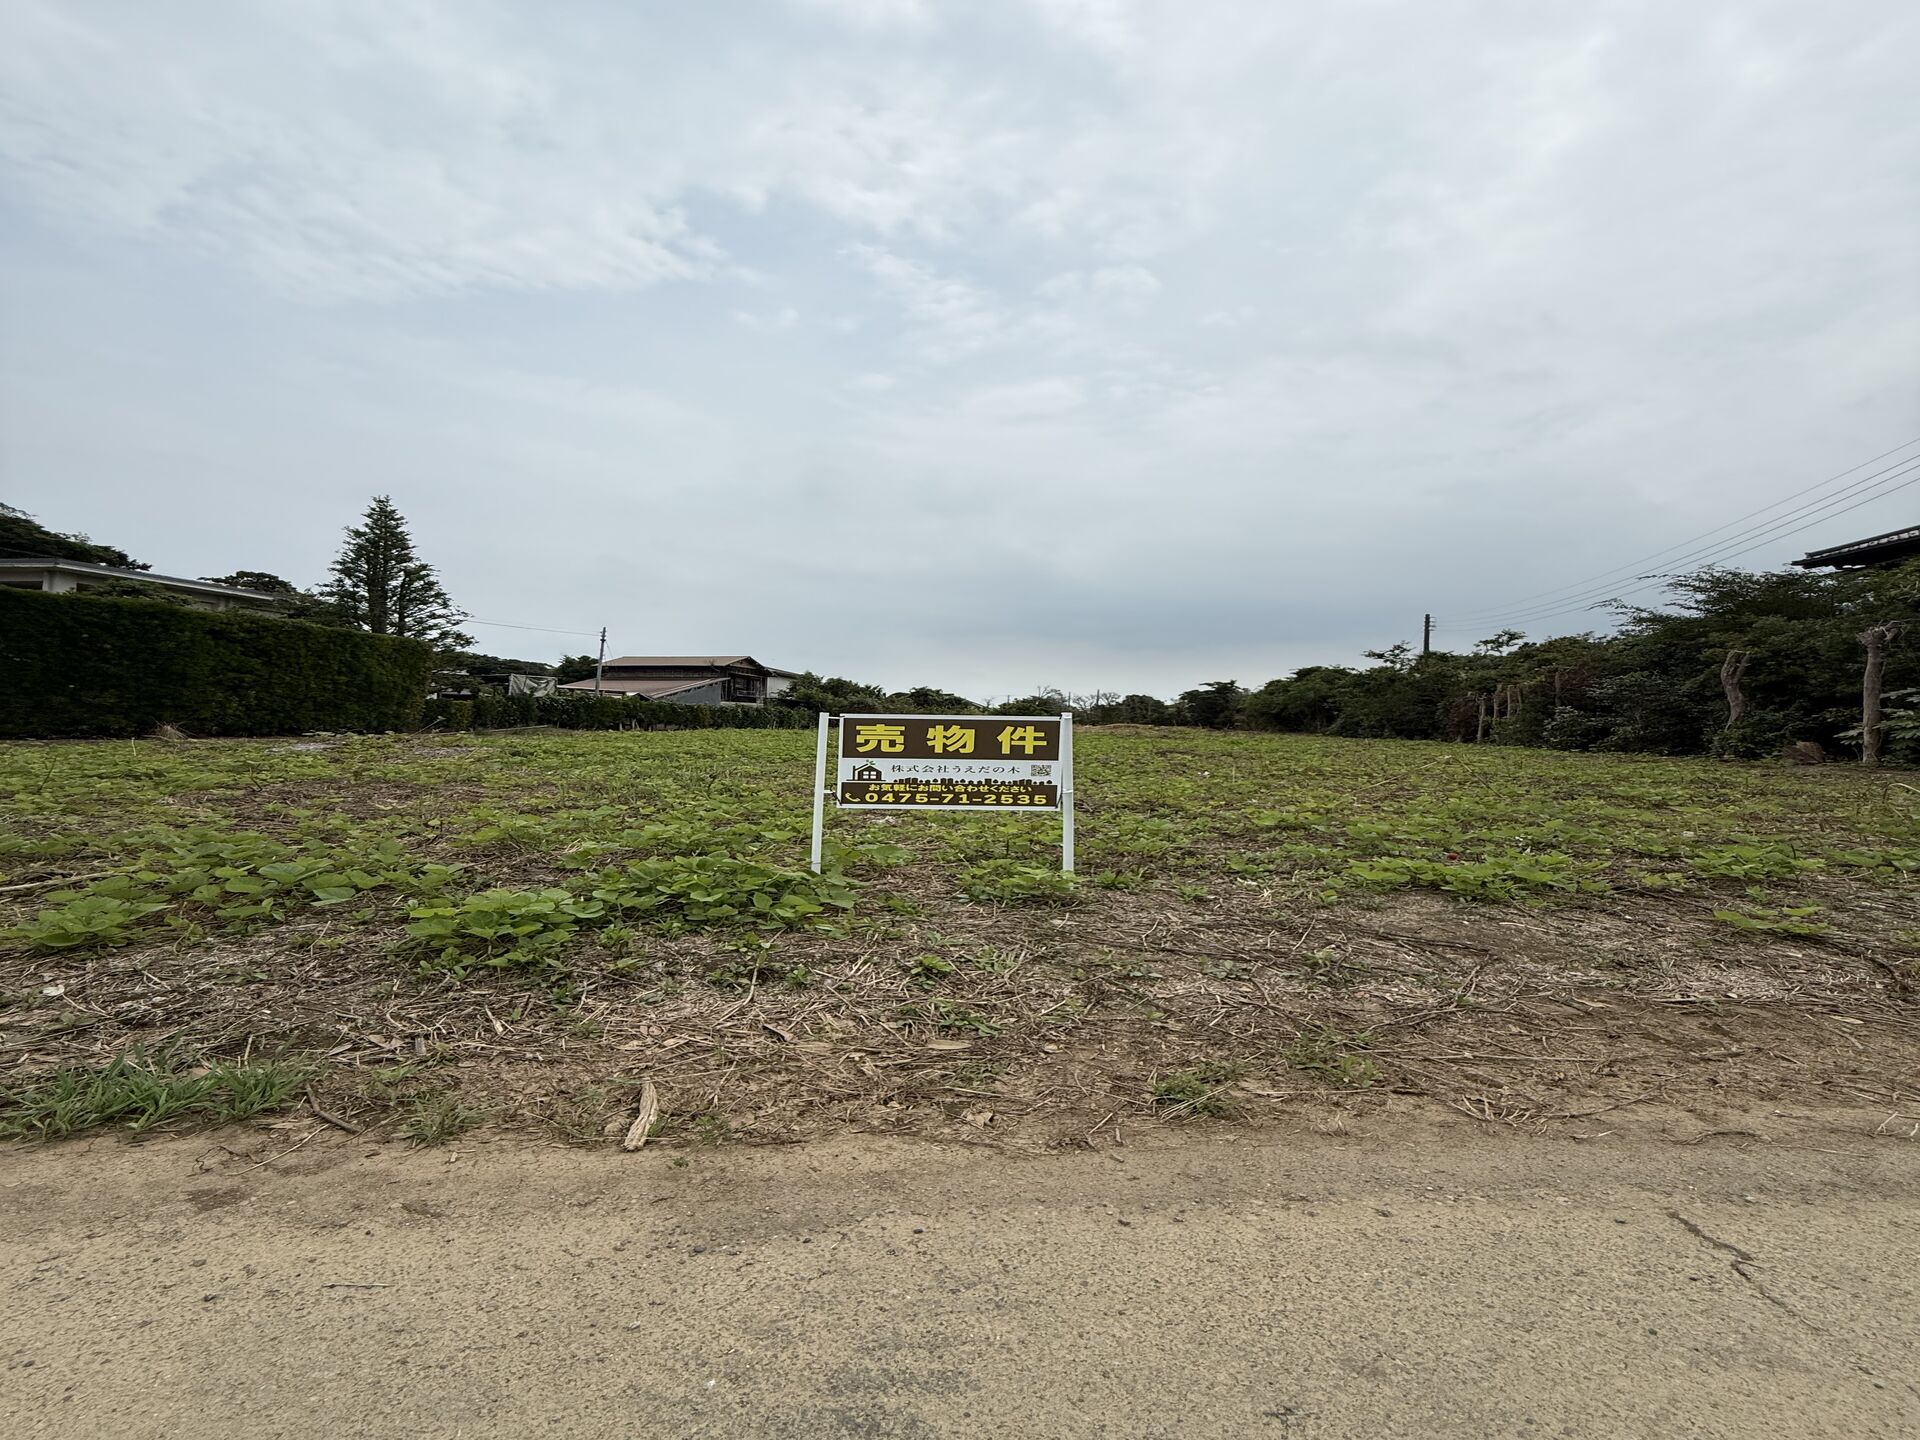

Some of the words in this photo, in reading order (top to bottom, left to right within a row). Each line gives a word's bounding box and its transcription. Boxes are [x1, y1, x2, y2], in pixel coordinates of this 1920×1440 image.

[855, 724, 1047, 754] 売物件
[892, 764, 1021, 774] 株式会社うえだの木
[868, 784, 1032, 793] お気軽にお問い合わせください
[865, 793, 1047, 804] 0475-71-2535
